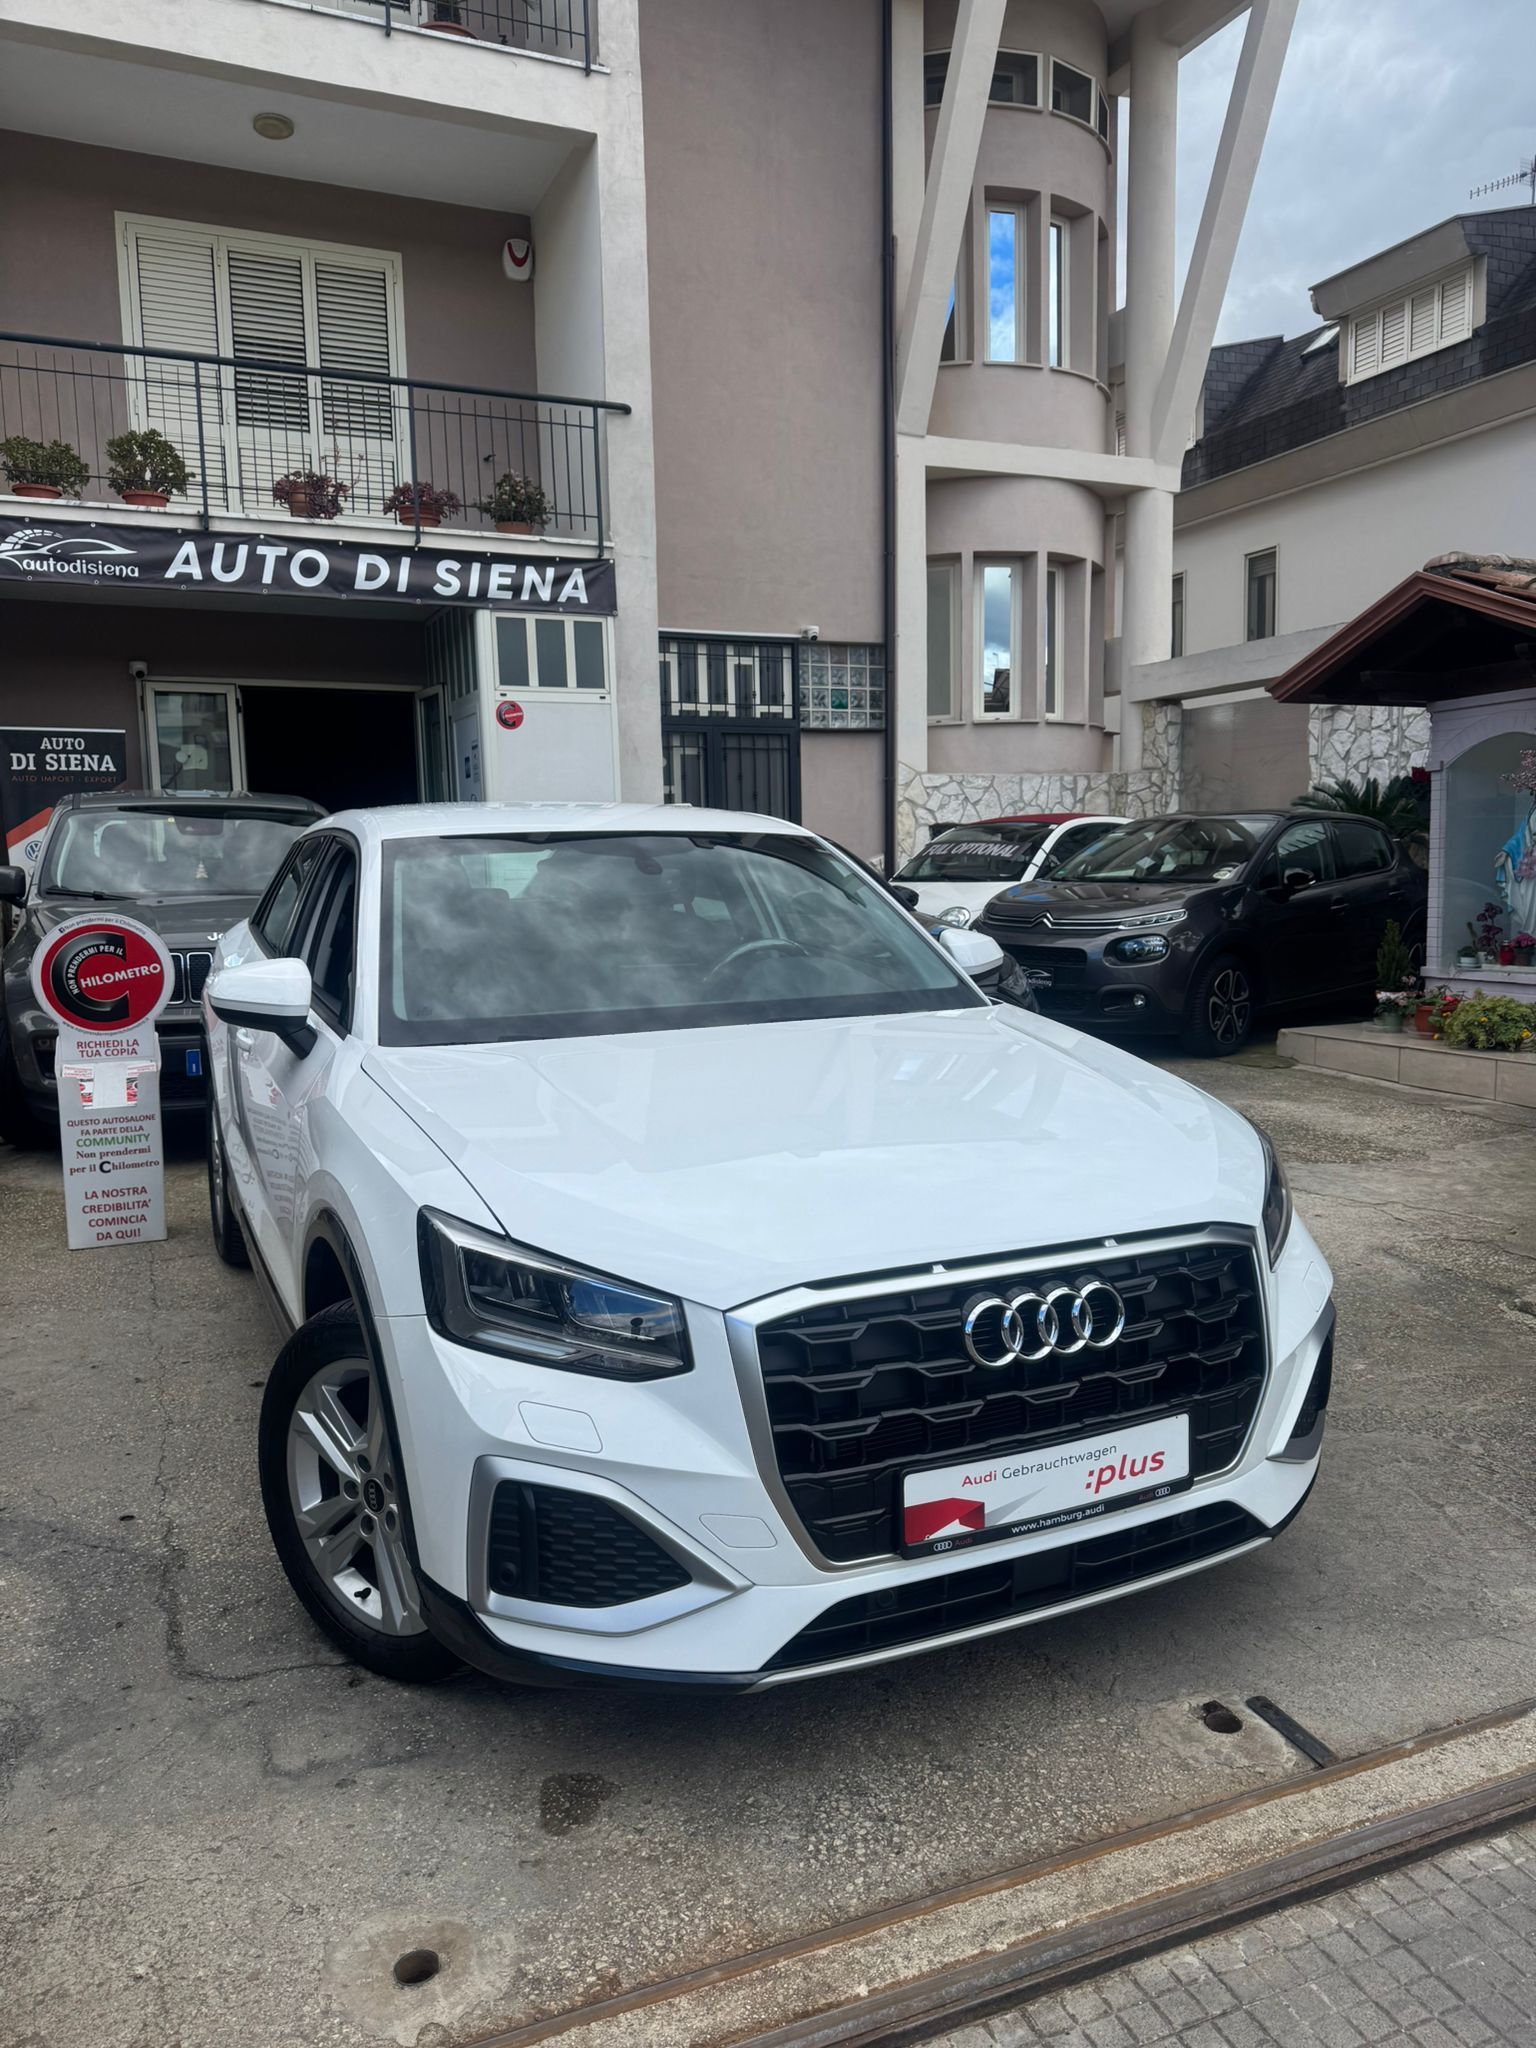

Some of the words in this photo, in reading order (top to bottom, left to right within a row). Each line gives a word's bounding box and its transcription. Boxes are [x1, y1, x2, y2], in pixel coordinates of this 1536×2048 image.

[22, 556, 139, 578] autodisiena
[164, 540, 330, 588] AUTO
[354, 553, 411, 593] DI
[432, 559, 589, 604] SIENA
[40, 737, 85, 750] AUTO
[10, 753, 37, 770] DI
[45, 753, 117, 772] SIENA
[11, 775, 38, 783] AUTO
[41, 775, 74, 783] IMPORT
[84, 775, 117, 783] EXPORT
[922, 842, 955, 857] FULL
[950, 842, 1021, 858] OPTIONAL
[99, 945, 115, 953] PER
[116, 946, 124, 956] IL
[67, 946, 98, 978] PRENDERMI
[68, 980, 80, 995] NON
[76, 1040, 124, 1050] RICHIEDI
[126, 1039, 140, 1047] LA
[79, 1049, 102, 1058] TUA
[104, 1047, 138, 1057] COPIA
[67, 1118, 100, 1128] QUESTO
[102, 1113, 157, 1125] AUTOSALONE
[92, 1127, 118, 1136] PARTE
[119, 1125, 145, 1134] DELLA
[76, 1133, 151, 1148] COMMUNITY
[76, 1151, 96, 1159] Non
[99, 1145, 151, 1160] prendermi
[69, 1167, 87, 1176] per
[89, 1164, 96, 1172] il
[99, 1160, 160, 1174] Chilometro
[84, 1190, 99, 1200] LA
[101, 1186, 148, 1198] NOSTRA
[88, 1213, 148, 1228] COMINCIA
[96, 1232, 113, 1241] DA
[115, 1228, 141, 1240] QUI!
[961, 1470, 998, 1488] Audi
[1001, 1445, 1117, 1480] Gebrauchtwagen
[1010, 1503, 1105, 1535] www.hamburg.audi
